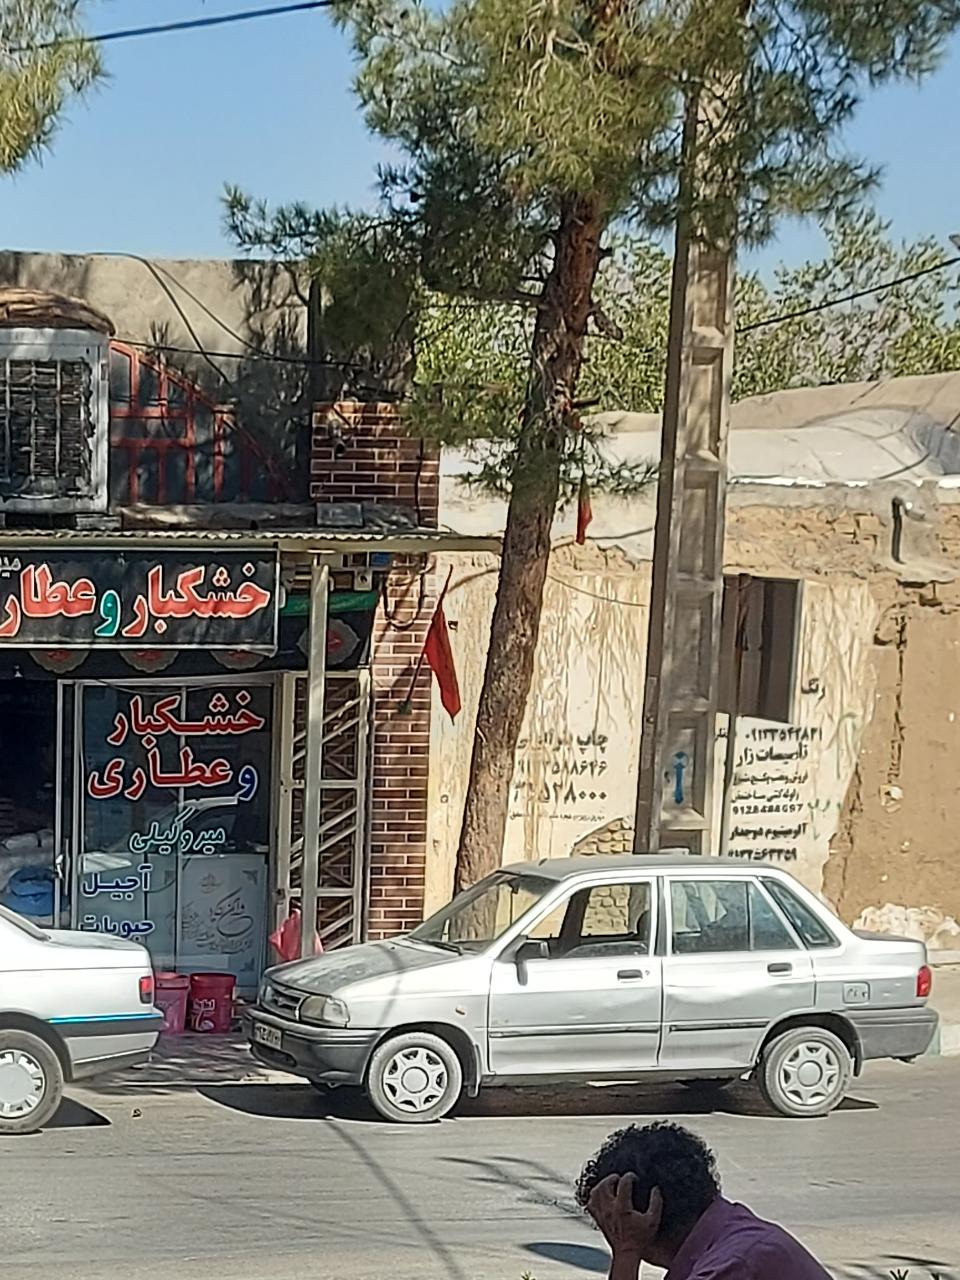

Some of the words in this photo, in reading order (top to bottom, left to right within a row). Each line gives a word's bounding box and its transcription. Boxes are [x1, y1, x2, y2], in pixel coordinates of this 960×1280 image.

[93, 589, 121, 637] و
[122, 562, 271, 638] خشکبار
[107, 690, 265, 748] خشکبار
[88, 747, 233, 800] عطاری
[237, 764, 258, 801] و
[82, 864, 153, 900] آجیل
